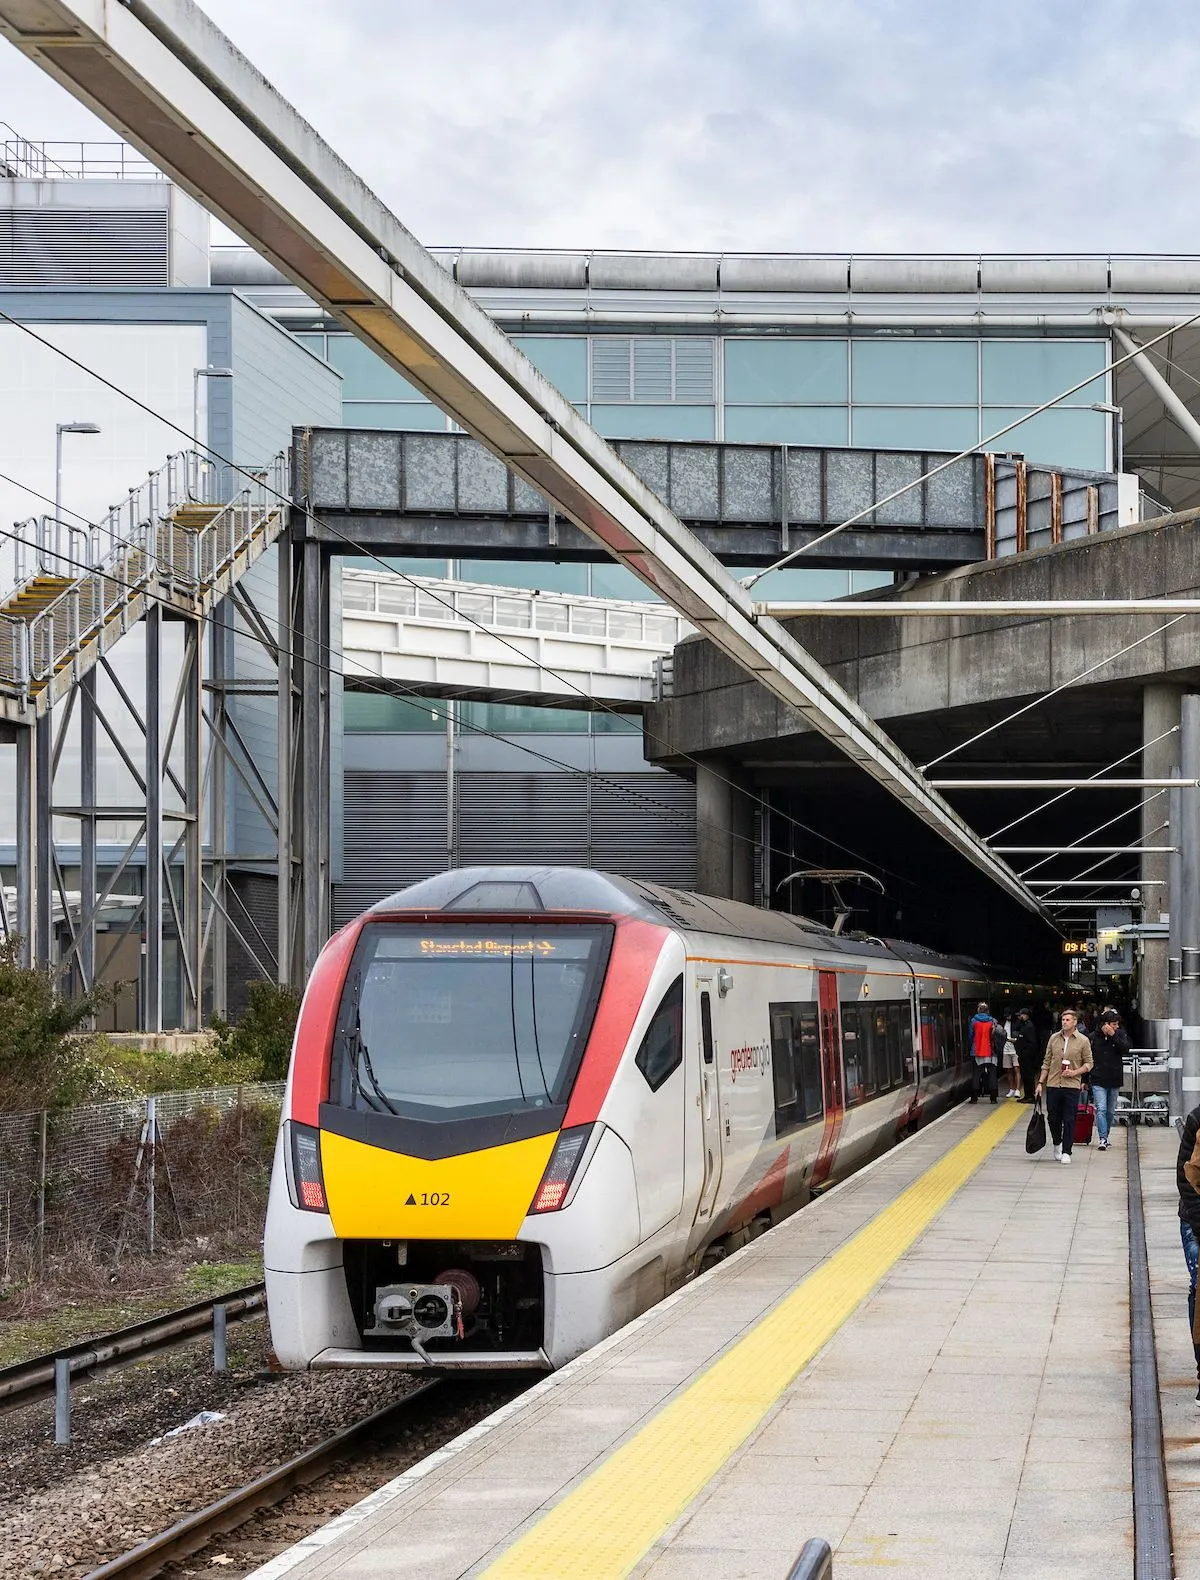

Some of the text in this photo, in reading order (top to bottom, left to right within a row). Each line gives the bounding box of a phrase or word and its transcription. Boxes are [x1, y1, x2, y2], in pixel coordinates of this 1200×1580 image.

[420, 941, 534, 956] Stansted Airport
[1087, 942, 1095, 952] 3
[420, 1193, 450, 1206] 102
